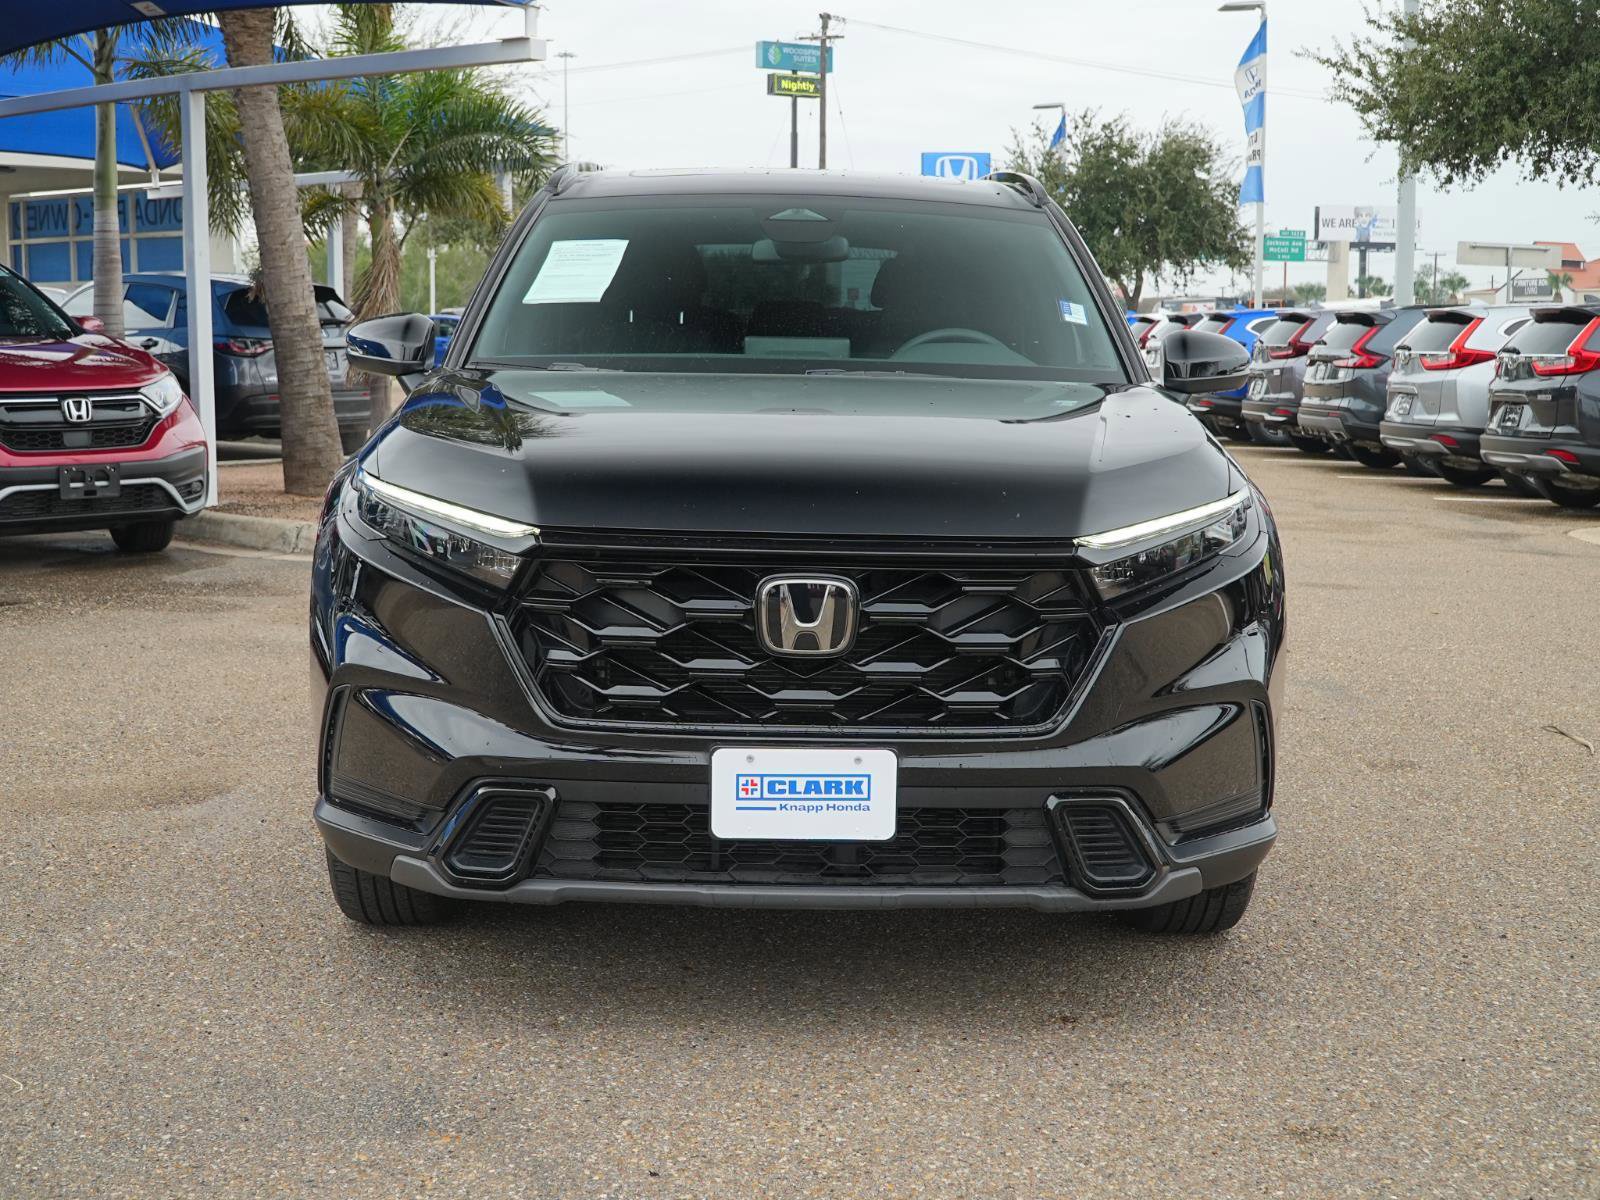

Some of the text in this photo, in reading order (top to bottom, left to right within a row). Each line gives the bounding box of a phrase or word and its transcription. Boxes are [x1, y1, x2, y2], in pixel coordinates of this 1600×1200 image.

[781, 79, 815, 91] Nightly
[1322, 218, 1357, 228] WE ARE
[767, 779, 865, 795] CLARK
[779, 803, 870, 813] Knapp Honda
